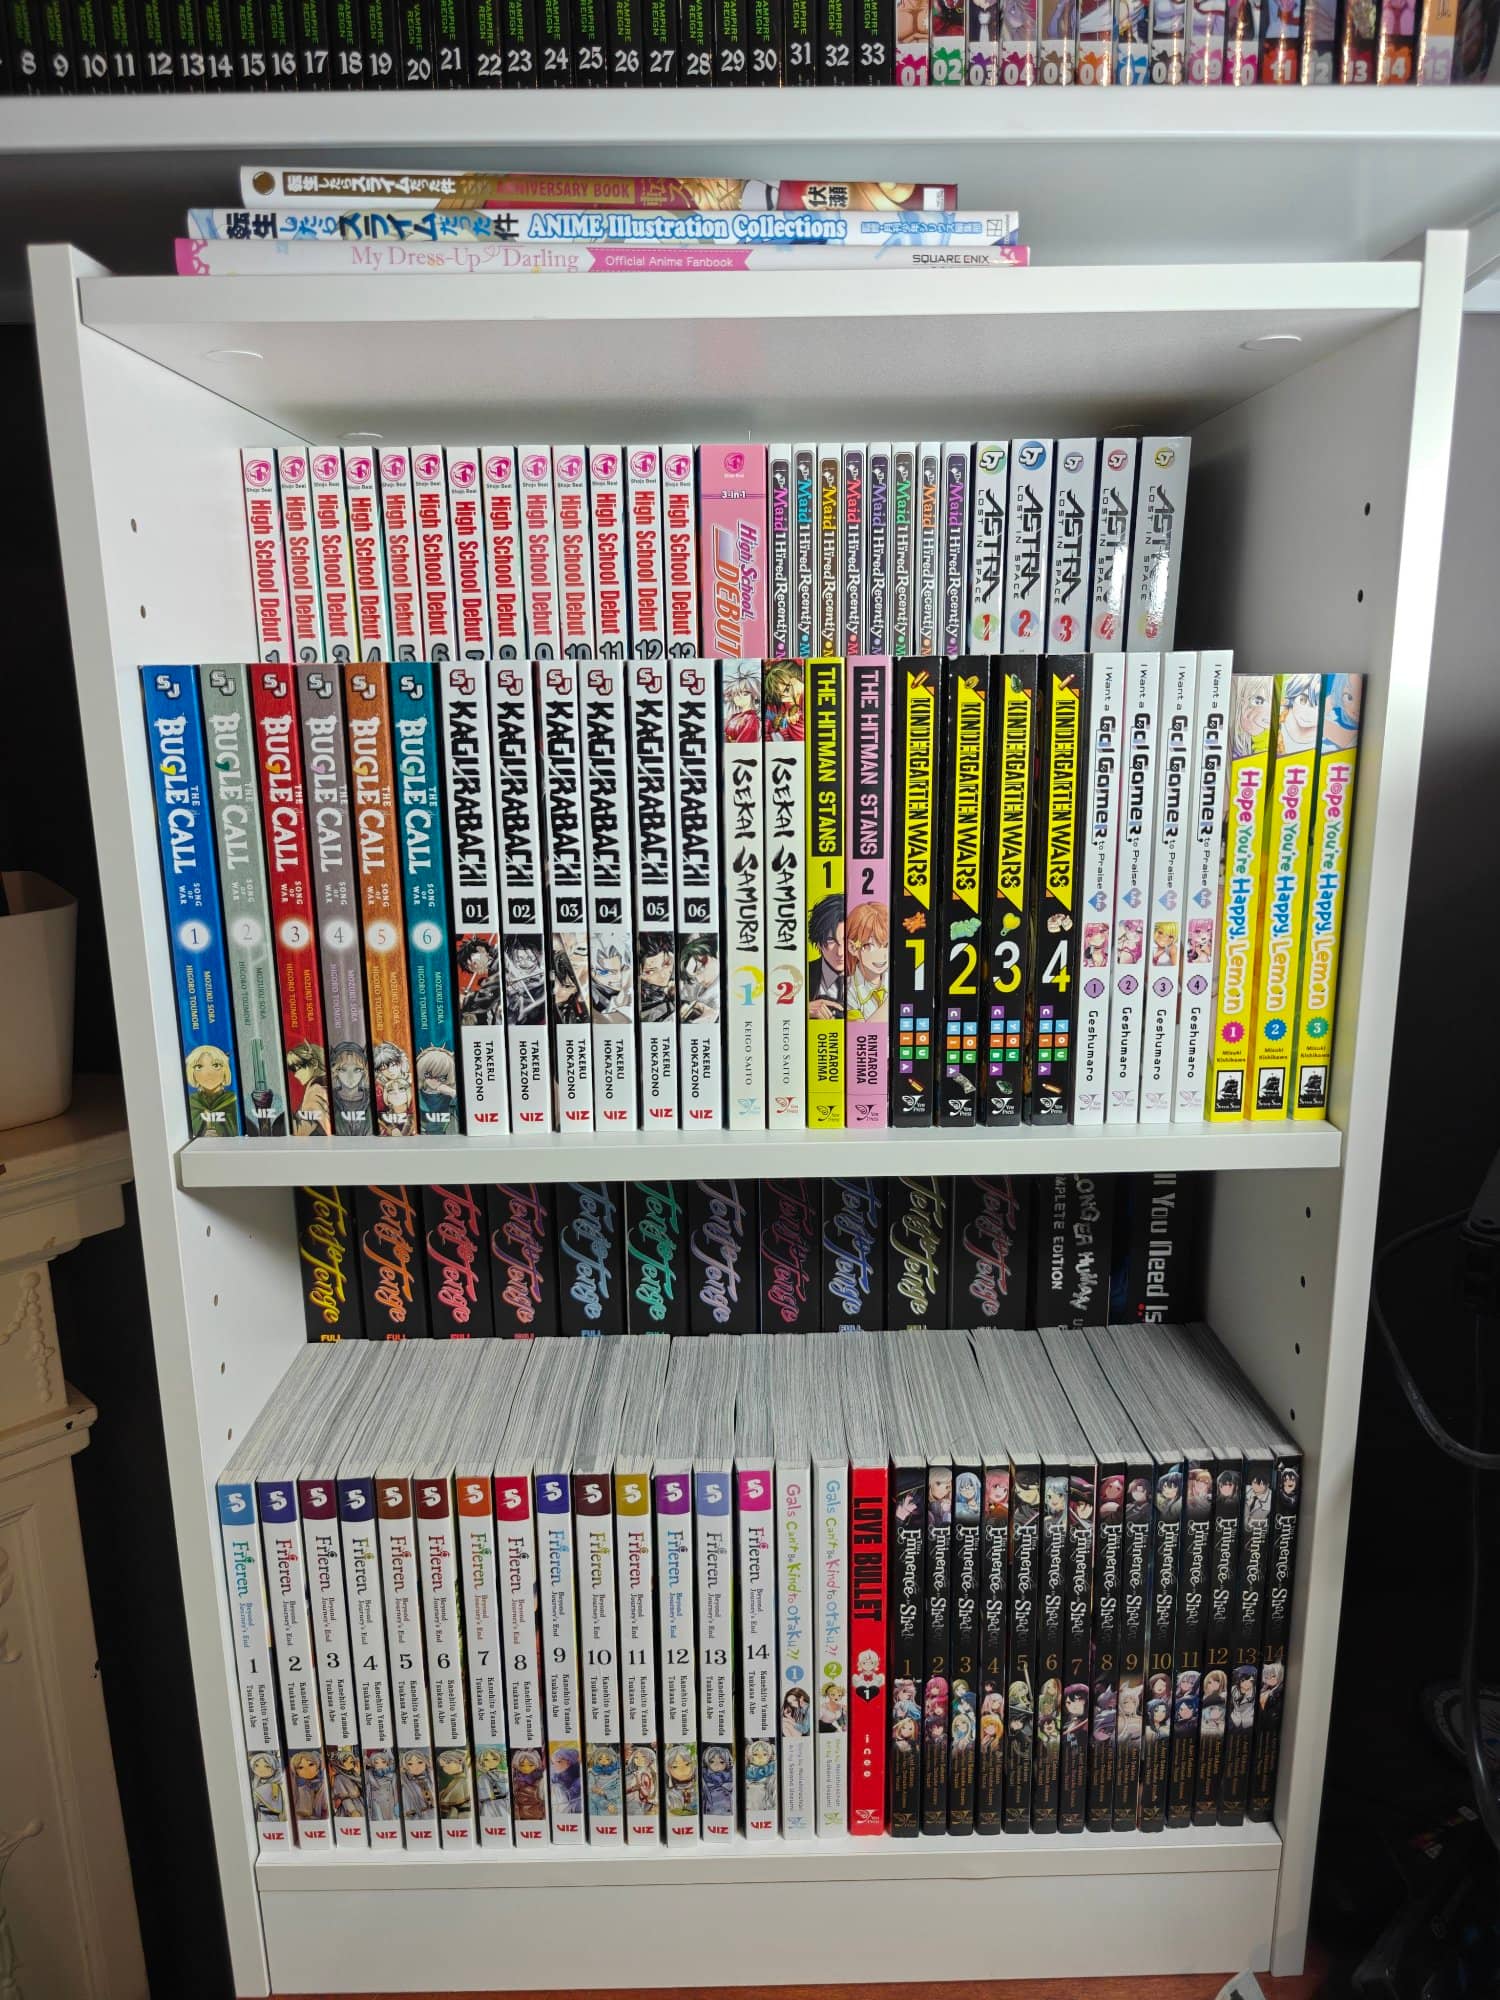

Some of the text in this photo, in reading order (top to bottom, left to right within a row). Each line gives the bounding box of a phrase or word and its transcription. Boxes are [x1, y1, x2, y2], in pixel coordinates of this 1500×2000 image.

[413, 4, 423, 52] VAMPIRE
[22, 52, 37, 75] 8
[148, 53, 173, 76] 12
[271, 52, 297, 76] 16
[407, 58, 431, 81] 20
[507, 49, 532, 72] 23
[649, 50, 674, 73] 27
[721, 49, 745, 72] 29
[790, 42, 812, 66] 31
[860, 43, 885, 66] 33
[933, 59, 963, 80] 02
[901, 66, 928, 86] 01
[1004, 63, 1033, 86] 04
[593, 182, 630, 198] BOOK
[528, 213, 608, 239] ANIME
[608, 214, 730, 240] Illustration
[731, 215, 848, 241] Collections
[352, 245, 579, 273] My Dress-Up Darling
[605, 255, 734, 269] Official Anime Fanbook
[912, 254, 990, 265] SQUARE ENIX
[251, 500, 273, 534] High
[798, 480, 812, 523] Maid
[950, 482, 964, 526] Maid
[981, 487, 1004, 604] ASTRA
[1020, 484, 1044, 601] ASTRA
[254, 540, 280, 592] School
[595, 494, 621, 634] High School Debut
[260, 598, 282, 642] Debut
[799, 574, 812, 636] Recently
[947, 574, 963, 638] Recently
[982, 614, 991, 640] 1
[1018, 610, 1031, 637] 2
[635, 640, 663, 661] 12
[1104, 672, 1113, 701] Want
[817, 667, 836, 854] THE HITMAN STANS
[860, 670, 880, 856] THE HITMAN STANS
[154, 714, 197, 874] BUGLE CALL
[191, 785, 201, 807] THE
[260, 714, 299, 873] BUGLE CALL
[448, 701, 487, 887] KAGURABACHI
[545, 701, 582, 887] KAGURABACHI
[907, 698, 931, 887] KINDERGARTEN WARS
[1049, 699, 1076, 889] KINDERGARTEN WARS
[731, 758, 759, 953] ISEKAI SAMURAI
[771, 757, 798, 952] ISEKAI SAMURAI
[1236, 825, 1253, 875] You're
[822, 861, 832, 889] 1
[861, 867, 874, 895] 2
[1096, 853, 1105, 890] Praise
[179, 884, 188, 905] WAR
[193, 882, 203, 908] SONG
[466, 904, 482, 918] 01
[561, 903, 579, 918] 03
[191, 928, 200, 945] 1
[290, 924, 301, 944] 3
[905, 939, 925, 991] 1
[1042, 940, 1071, 993] 4
[1226, 942, 1249, 1011] Lemon
[739, 983, 755, 1006] 1
[776, 982, 794, 1004] 2
[485, 1040, 496, 1081] TAKERU
[744, 1021, 753, 1086] KEIGO SAITO
[817, 1033, 827, 1081] OHSHIMA
[829, 1032, 839, 1082] RINTAROU
[1086, 1010, 1099, 1081] Geshumaro
[473, 1041, 484, 1101] HOKAZONO
[200, 1111, 226, 1123] VIZ
[474, 1113, 499, 1123] VIZ
[1151, 1192, 1176, 1233] You
[1051, 1176, 1067, 1291] MPLETE EDITION
[1070, 1251, 1098, 1311] HUMAN
[786, 1484, 802, 1518] Gals
[276, 1538, 298, 1597] Frieren
[749, 1528, 769, 1584] Frieren
[853, 1497, 883, 1622] LOVE BULLET
[900, 1528, 921, 1598] Eminence
[1156, 1521, 1180, 1638] Eminence Shado
[288, 1656, 302, 1671] 2
[747, 1644, 770, 1660] 14
[904, 1659, 911, 1676] 1
[1152, 1653, 1172, 1670] 10
